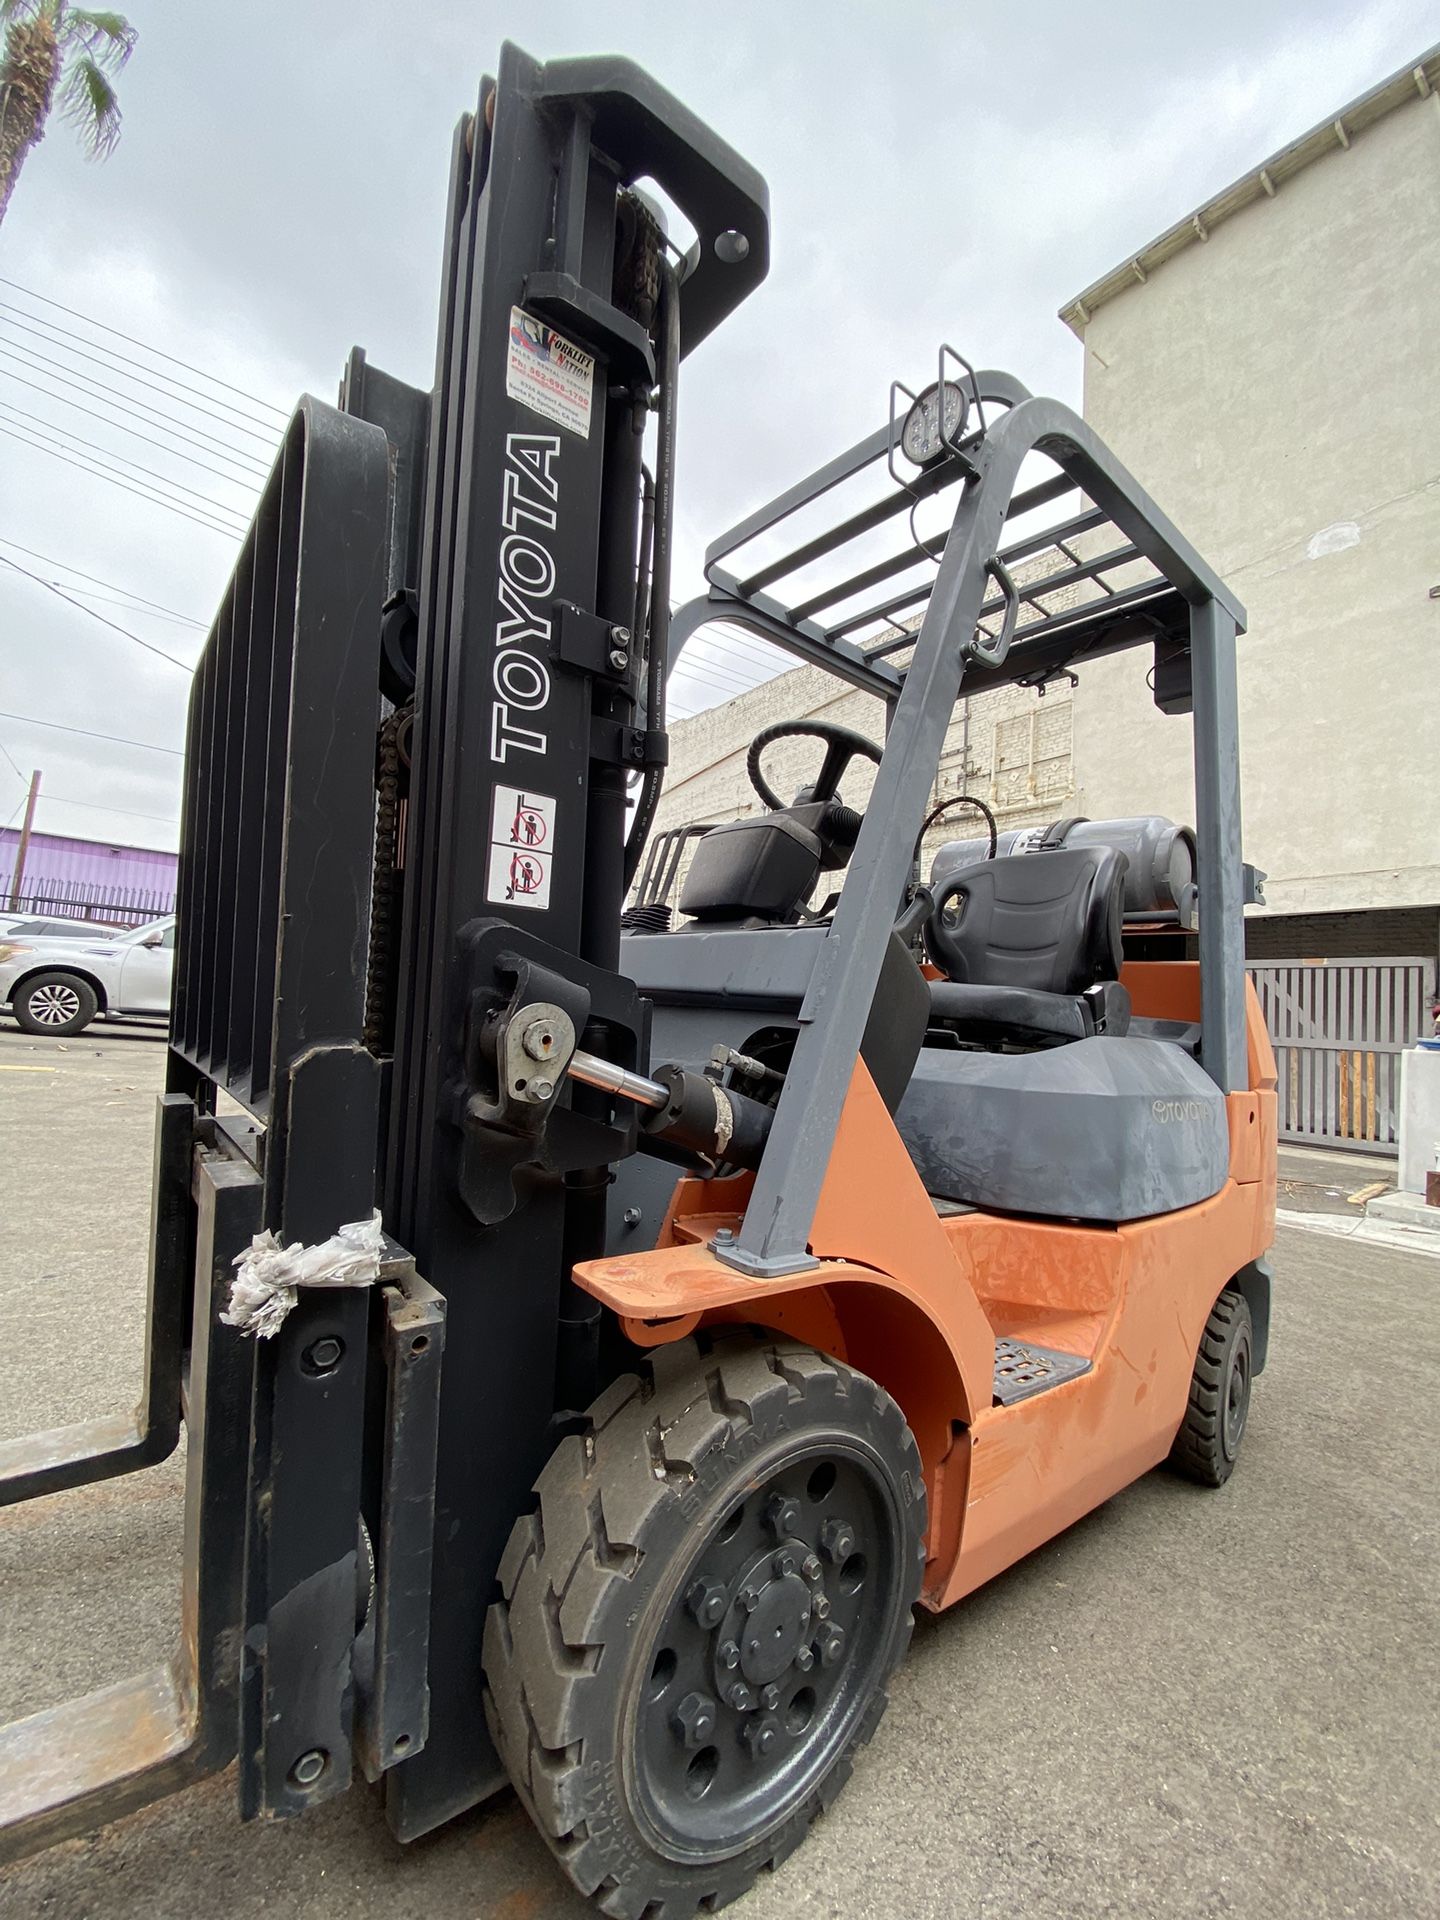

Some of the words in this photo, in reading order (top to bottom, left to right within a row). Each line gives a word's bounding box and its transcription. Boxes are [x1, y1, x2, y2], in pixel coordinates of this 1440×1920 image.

[549, 332, 594, 368] FORKLIFT
[557, 353, 590, 381] NATION
[490, 433, 561, 763] TOYOTA
